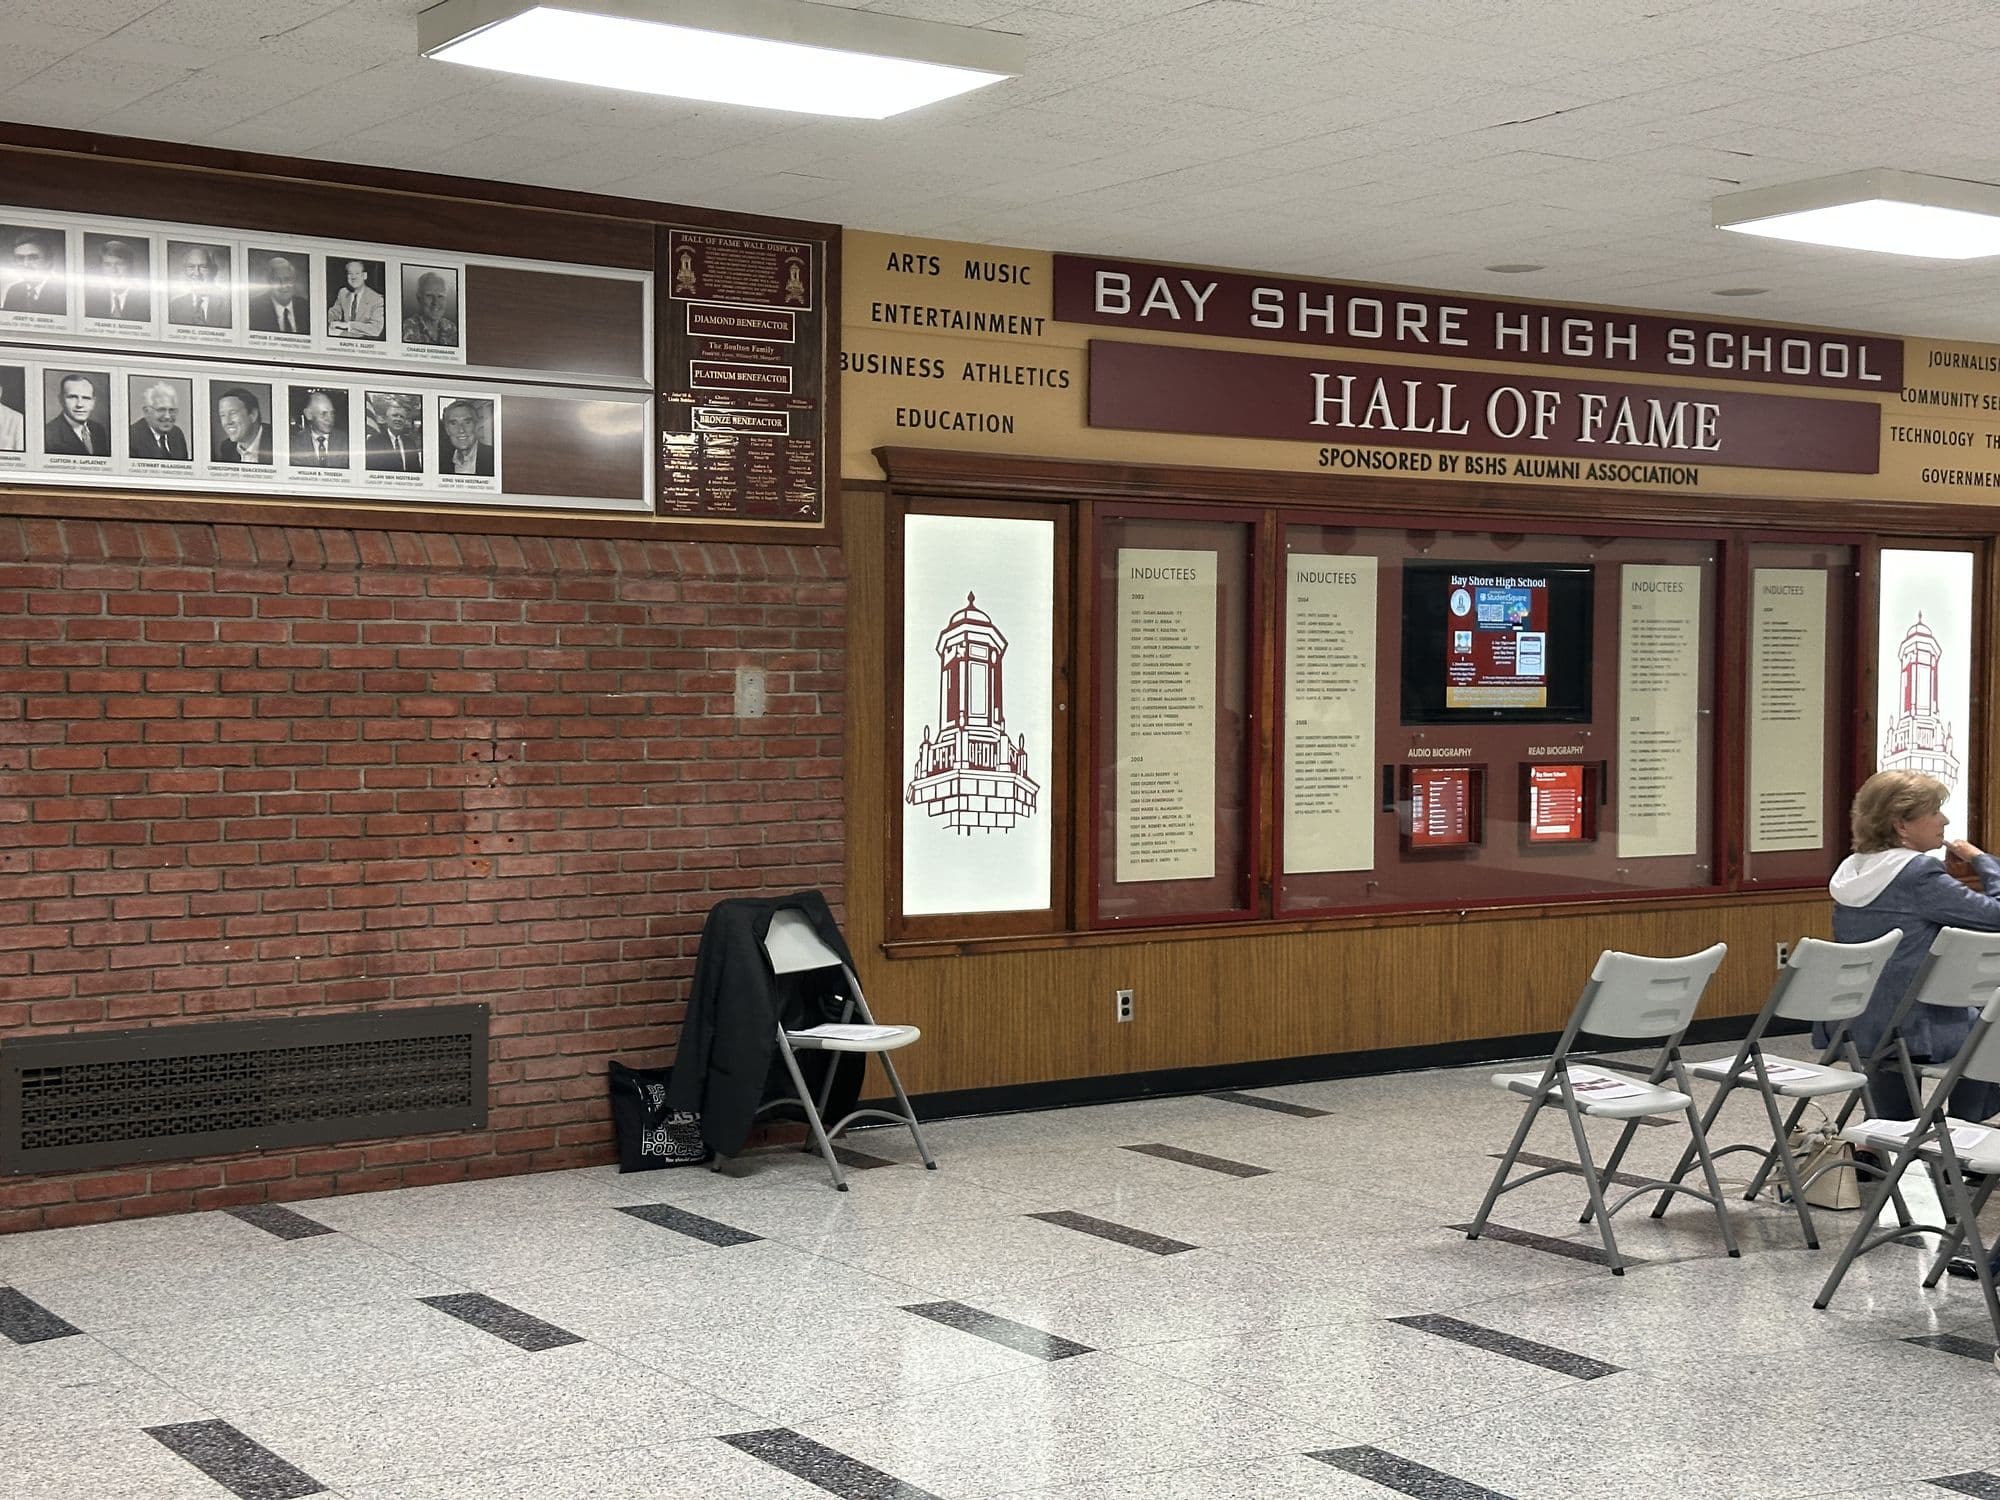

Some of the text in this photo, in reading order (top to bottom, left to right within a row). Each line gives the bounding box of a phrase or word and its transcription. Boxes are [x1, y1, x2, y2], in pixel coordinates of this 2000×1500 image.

[682, 234, 702, 244] HALL
[720, 239, 740, 247] FAME
[744, 241, 765, 249] WALL
[768, 244, 799, 253] DISPLAY
[886, 252, 1031, 285] ARTS MUSIC
[694, 314, 789, 330] DIAMOND BENEFACTOR
[872, 302, 1045, 336] ENTERTAINMENT
[1096, 270, 1882, 382] BAY SHORE HIGH SCHOOL
[840, 352, 1070, 388] BUSINESS ATHLETICS
[1928, 351, 2000, 371] JOURNALIS
[695, 370, 788, 383] PLATINUM BENEFACTOR
[1900, 387, 2000, 411] COMMUNITY SE
[700, 415, 782, 427] BRONZE BENEFACTOR
[896, 408, 1014, 434] EDUCATION
[1308, 372, 1723, 452] HALL OF FAME
[1891, 426, 1974, 447] TECHNOLOGY
[1319, 448, 1698, 485] SPONSORED BY BSHS ALUMNI ASSOCIATION
[1131, 568, 1196, 580] INDUCTEES
[1297, 571, 1357, 584] INDUCTEES
[1451, 575, 1546, 589] Bay Shore High School
[1632, 581, 1683, 592] INDUCTEES
[1763, 585, 1804, 595] INDUCTEES
[1408, 748, 1472, 758] AUDIO BIOGRAPHY
[1528, 746, 1584, 755] READ BIOGRAPHY
